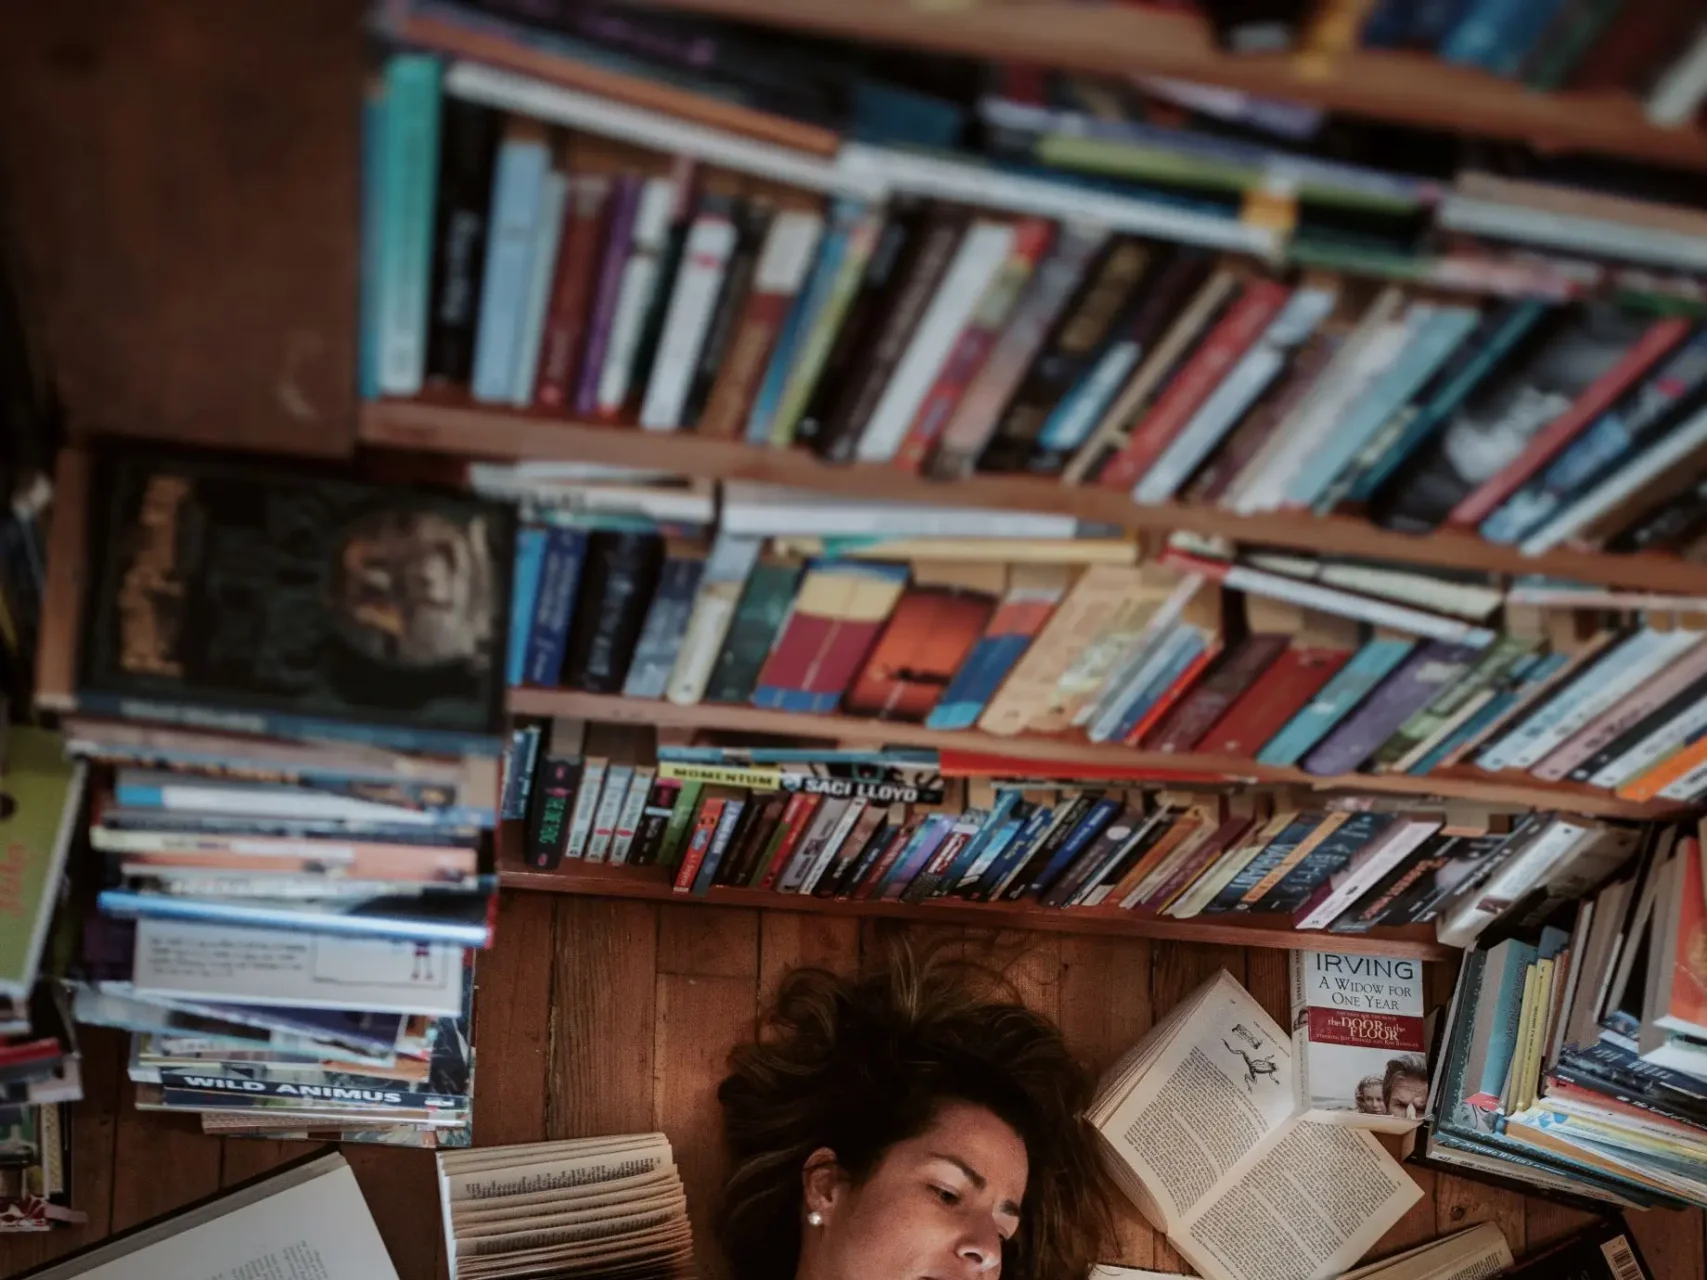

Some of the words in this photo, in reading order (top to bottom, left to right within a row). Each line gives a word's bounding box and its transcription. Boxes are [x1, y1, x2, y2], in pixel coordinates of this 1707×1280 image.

[674, 769, 772, 786] MOMENTUM
[856, 784, 918, 802] LLOYD
[1316, 953, 1414, 980] IRVING
[1319, 977, 1330, 989] A
[1335, 978, 1384, 994] WIDOW
[1388, 986, 1412, 997] FOR
[1332, 992, 1360, 1007] ONE
[1364, 996, 1400, 1010] YEAR
[1327, 1017, 1341, 1026] the
[1341, 1017, 1384, 1030] DOOR
[1350, 1026, 1398, 1040] FLOOR
[184, 1076, 266, 1092] WILD
[275, 1084, 402, 1103] ANIMUS
